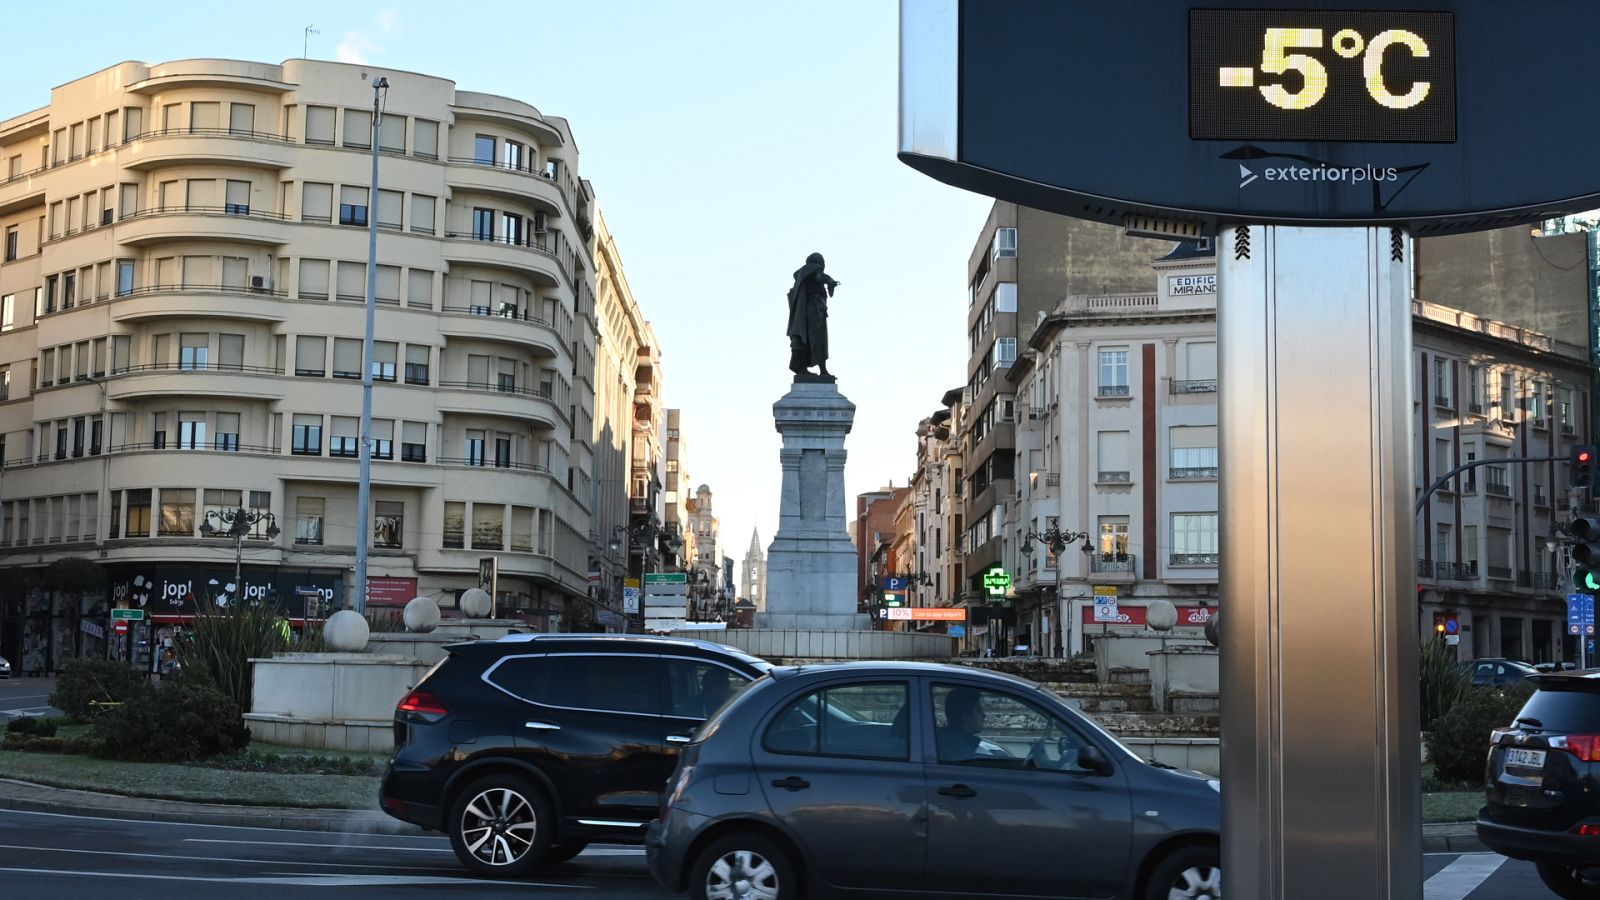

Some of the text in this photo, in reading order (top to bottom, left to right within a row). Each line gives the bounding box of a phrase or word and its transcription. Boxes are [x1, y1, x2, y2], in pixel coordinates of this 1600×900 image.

[1219, 27, 1431, 110] -5°C
[1264, 163, 1398, 185] exteriorplus
[1177, 276, 1214, 286] EDIFIC
[113, 581, 129, 601] jop!
[161, 579, 192, 600] jop!
[890, 578, 898, 590] P
[891, 609, 909, 617] 10%
